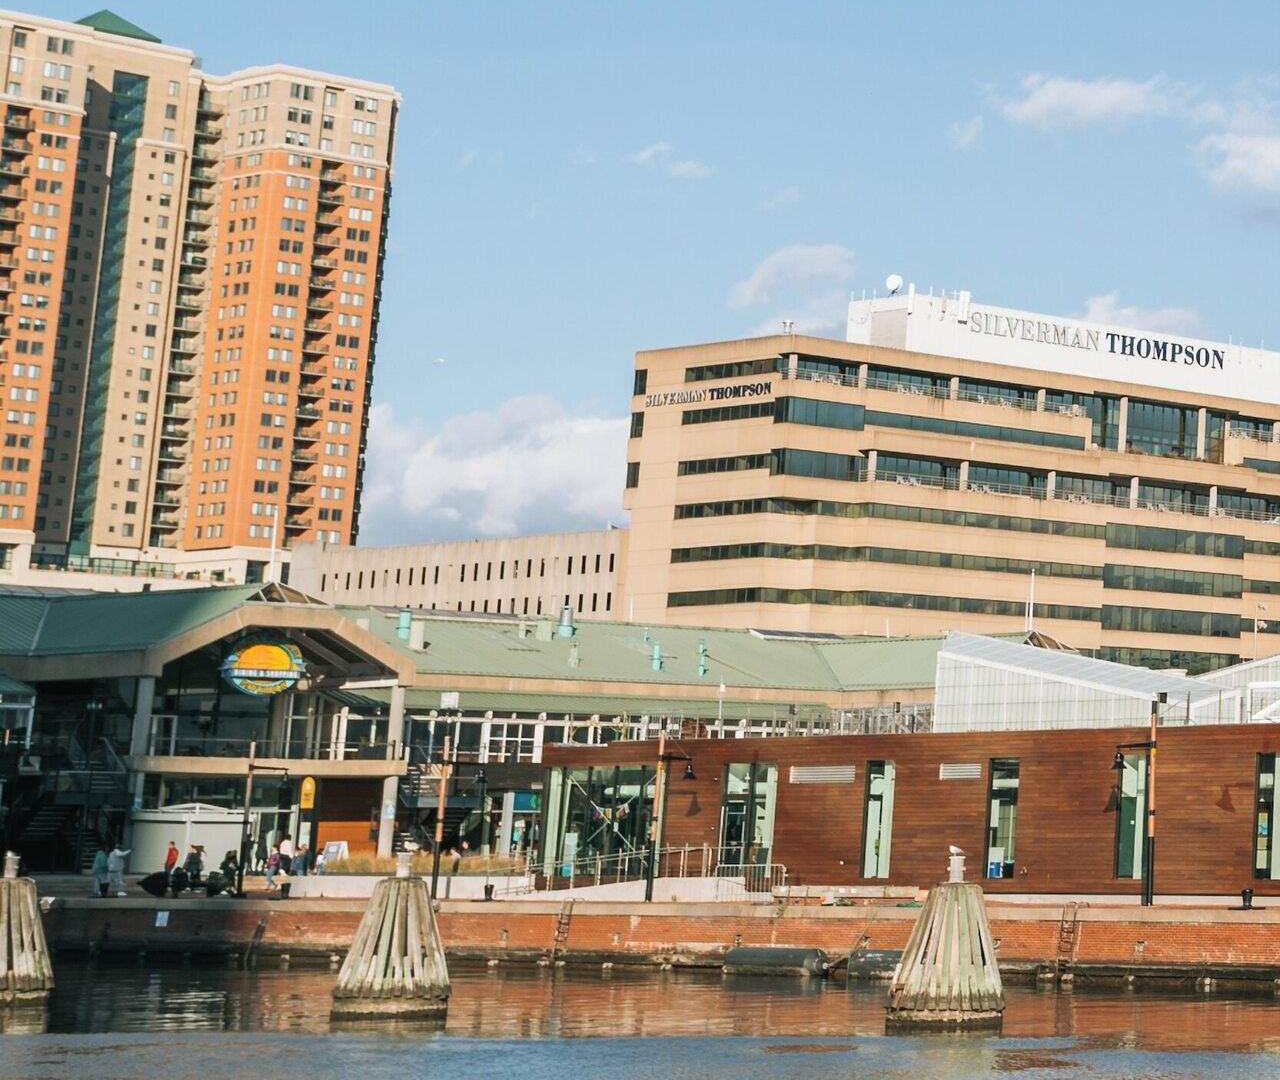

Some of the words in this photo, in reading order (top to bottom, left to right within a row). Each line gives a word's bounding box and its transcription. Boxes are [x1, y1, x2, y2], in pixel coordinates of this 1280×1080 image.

[970, 311, 1100, 351] SILVERMAN
[1106, 332, 1225, 370] THOMPSON
[709, 382, 772, 401] THOMPSON
